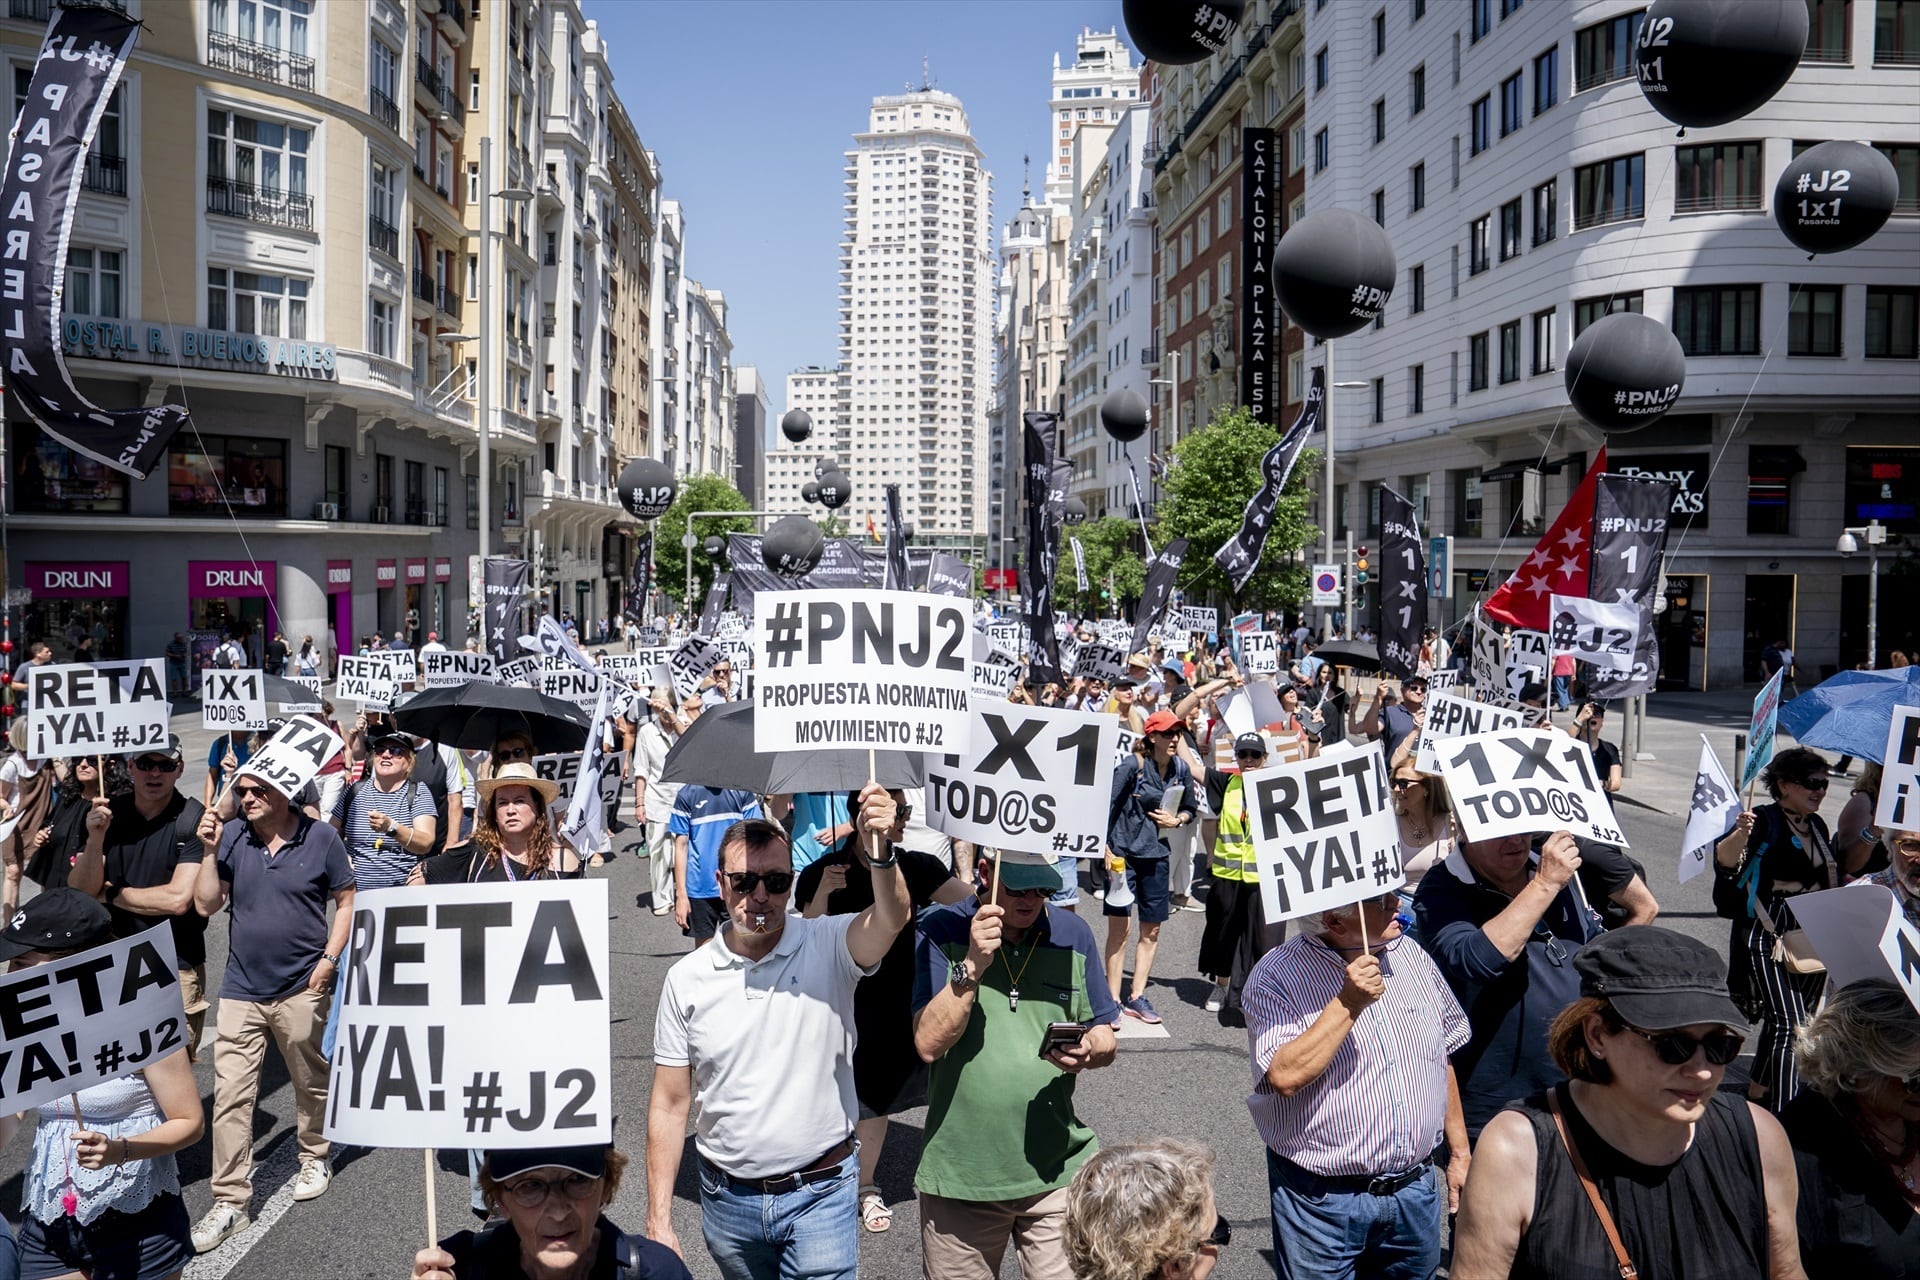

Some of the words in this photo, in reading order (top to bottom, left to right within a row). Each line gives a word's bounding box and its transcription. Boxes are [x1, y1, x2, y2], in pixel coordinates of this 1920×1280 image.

[1194, 4, 1237, 41] #PN
[1797, 169, 1851, 193] #J2
[1253, 139, 1265, 273] CATALONIA
[1797, 198, 1841, 217] 1x1
[1352, 285, 1389, 308] #PN
[1253, 285, 1264, 361] PLAZA
[64, 319, 138, 350] OSTAL
[149, 327, 170, 354] R.
[184, 331, 268, 364] BUENOS
[276, 341, 335, 370] AIRES
[1253, 373, 1264, 425] ESP
[1614, 384, 1679, 406] #PNJ2
[1618, 404, 1669, 415] PASARELA
[633, 486, 671, 505] #J2
[1671, 492, 1703, 513] A'S
[1600, 518, 1666, 533] #PNJ2
[780, 553, 810, 572] #J2
[45, 571, 111, 588] DRUNI
[206, 570, 263, 586] DRUNI
[721, 620, 744, 629] RETA
[1168, 613, 1182, 627] TA
[1184, 608, 1216, 620] RETA
[1113, 630, 1134, 641] #PN
[1184, 620, 1201, 630] ¡YA!
[766, 602, 965, 671] #PNJ2
[1063, 637, 1079, 656] #PN
[1241, 634, 1275, 651] ETA
[1475, 626, 1500, 666] X1
[1517, 634, 1547, 656] TA
[1553, 623, 1632, 652] #J2
[428, 655, 492, 676] #PNJ2
[603, 657, 637, 669] RETA
[640, 650, 675, 666] RET
[704, 651, 724, 669] #J2
[1080, 645, 1123, 666] RETA
[1256, 660, 1276, 670] #J2
[341, 659, 392, 681] RETA
[397, 672, 414, 681] #J2
[500, 659, 538, 680] RETA
[971, 665, 1007, 687] PNJ2
[35, 666, 164, 710] RETA
[205, 674, 258, 700] 1X1
[340, 680, 369, 697] ¡YA!
[370, 689, 389, 701] #J2
[427, 677, 461, 685] PROPUESTA
[1426, 673, 1455, 689] RETA
[762, 682, 871, 708] PROPUESTA
[876, 683, 967, 713] NORMATIVA
[205, 704, 246, 724] TOD@S
[246, 720, 264, 728] #J2
[37, 712, 104, 755] ¡YA!
[112, 723, 164, 747] #J2
[280, 719, 333, 767] TA
[795, 719, 911, 744] MOVIMIENTO
[916, 723, 943, 746] #J2
[944, 713, 1100, 786] X1
[252, 756, 301, 792] #J2
[536, 756, 621, 781] REA
[1450, 737, 1596, 792] 1X1
[929, 773, 1056, 835] TOD@S
[1463, 787, 1589, 824] TOD@S
[1052, 832, 1100, 853] #J2
[1591, 823, 1624, 844] #J2
[1272, 830, 1366, 913] ¡YA!
[1372, 841, 1403, 887] #J
[10, 910, 27, 931] J2
[344, 899, 604, 1008] RETA
[0, 941, 177, 1041] ETA
[93, 1016, 182, 1077] #J2
[329, 1024, 446, 1129] ¡YA!
[463, 1067, 598, 1133] #J2
